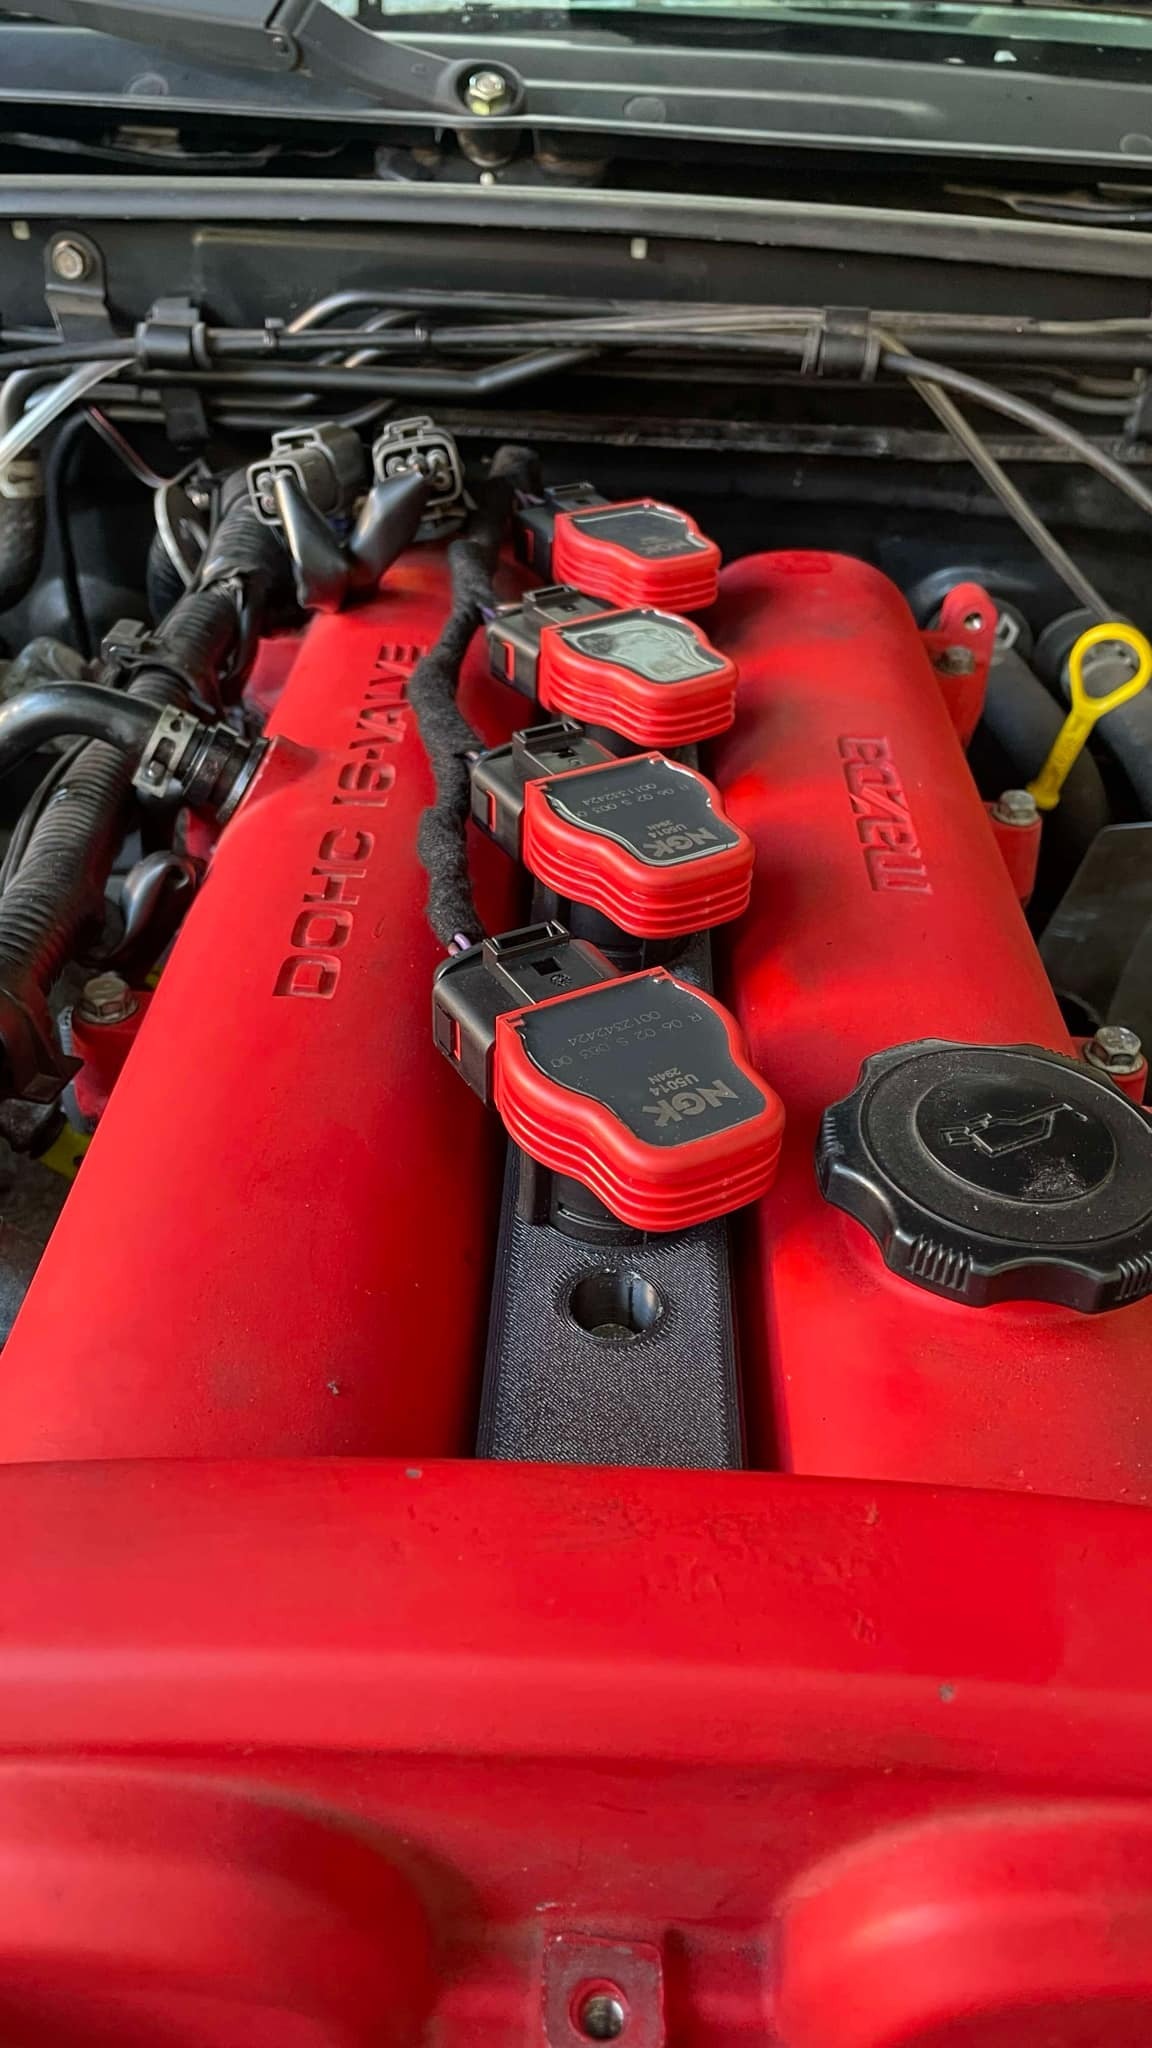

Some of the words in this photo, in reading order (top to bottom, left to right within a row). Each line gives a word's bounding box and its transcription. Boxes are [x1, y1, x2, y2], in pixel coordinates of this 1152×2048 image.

[643, 827, 718, 857] NGK
[272, 827, 375, 1000] DOHC
[661, 1019, 684, 1031] 06
[687, 1012, 703, 1023] R
[635, 1028, 657, 1040] 02
[648, 1067, 681, 1084] 294N
[649, 1073, 700, 1097] U5014
[642, 1079, 739, 1127] NGK
